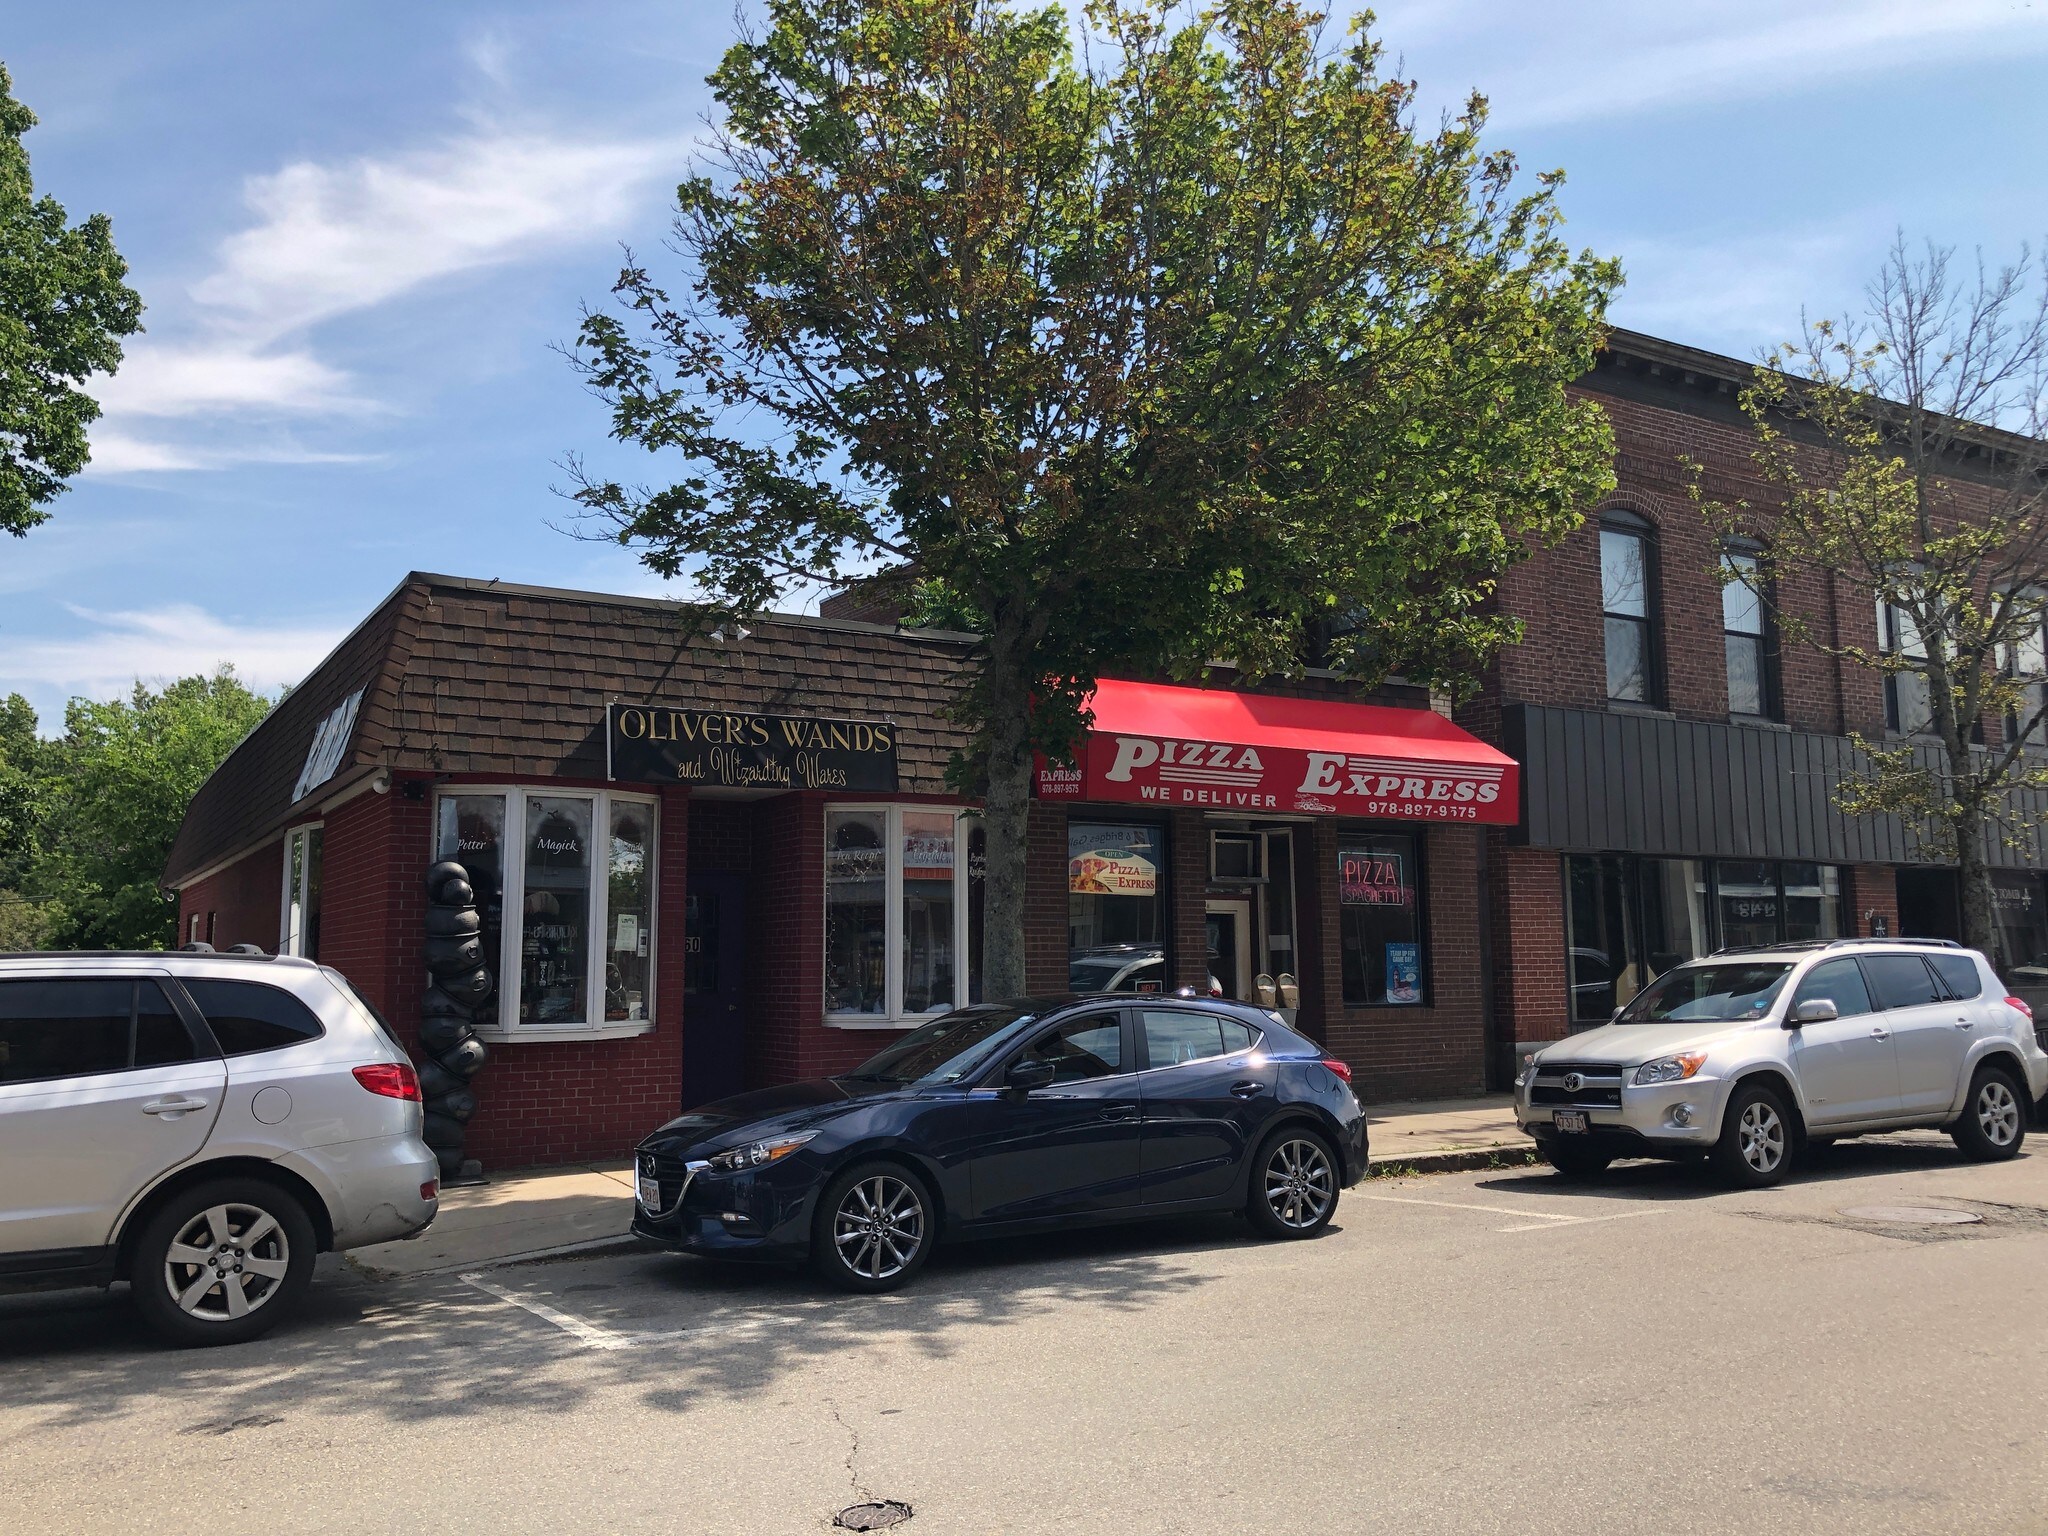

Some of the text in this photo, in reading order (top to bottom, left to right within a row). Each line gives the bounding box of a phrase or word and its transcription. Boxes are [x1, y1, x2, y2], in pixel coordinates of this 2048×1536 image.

[619, 709, 892, 754] OLIVER'S WANDS
[678, 746, 846, 789] and Wizarding Wares
[1040, 769, 1083, 782] EXPRESS
[1104, 737, 1500, 803] PIZZA EXPRESS
[1041, 783, 1079, 794] 978-897-9575
[1140, 785, 1277, 807] WE DELIVER
[456, 839, 487, 851] Potter
[536, 838, 579, 855] Magick
[1109, 861, 1141, 876] PIZZA
[1345, 860, 1397, 885] PIZZA
[1118, 876, 1155, 890] EXPRESS
[1345, 889, 1400, 903] SPAGHETTI
